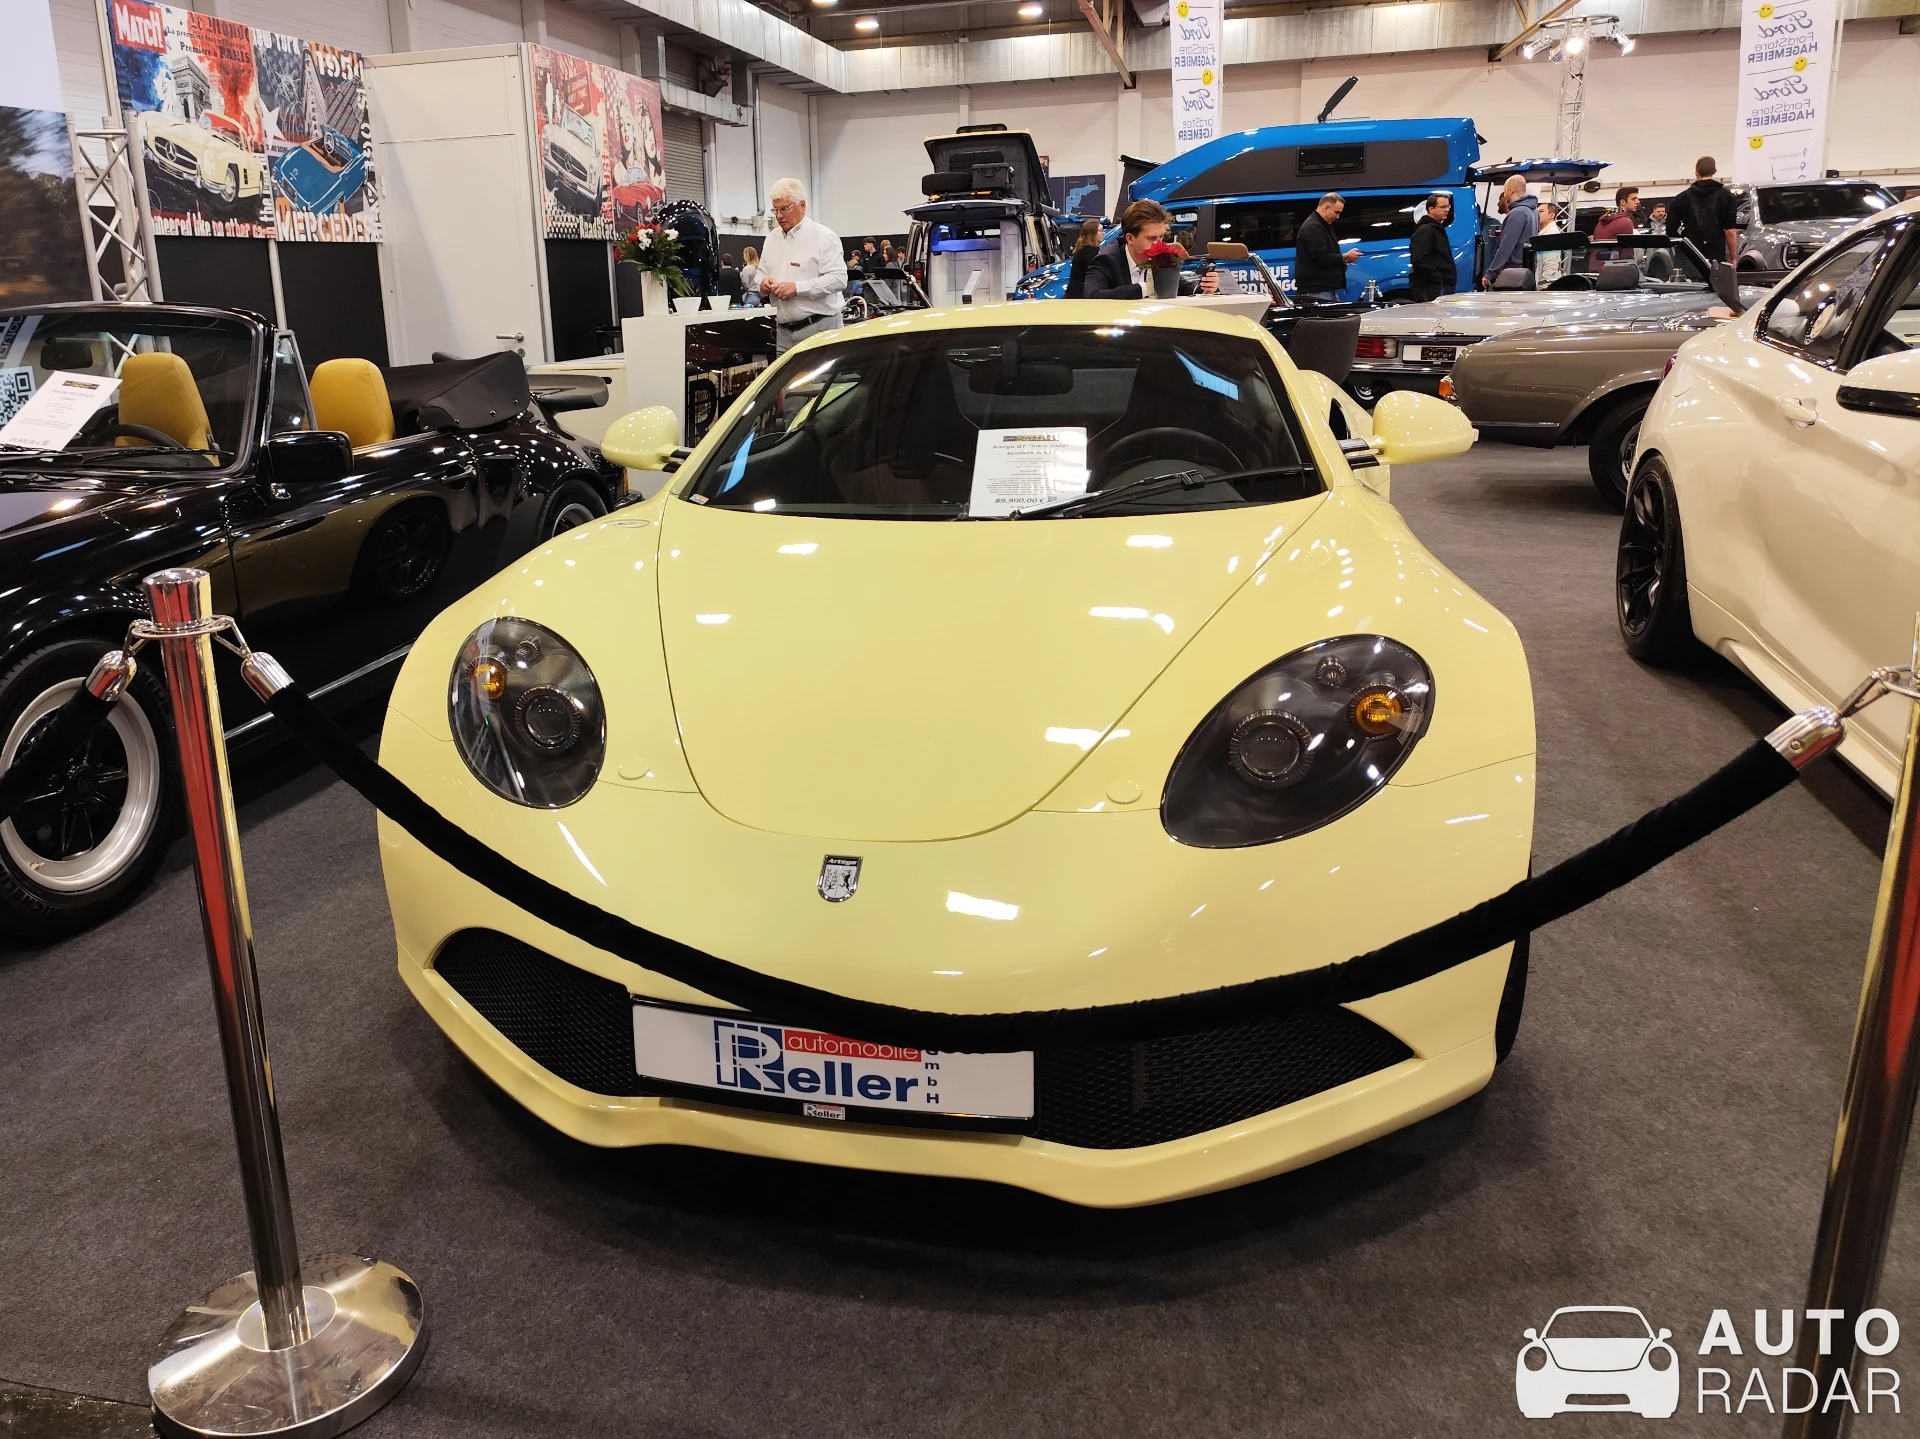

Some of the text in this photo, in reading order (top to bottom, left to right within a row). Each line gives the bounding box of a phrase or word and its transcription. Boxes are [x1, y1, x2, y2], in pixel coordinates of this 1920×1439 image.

[114, 2, 164, 49] MATCH
[220, 46, 251, 63] PARIS
[1231, 269, 1248, 282] ER
[827, 858, 858, 866] Artega
[713, 1019, 919, 1103] Reller
